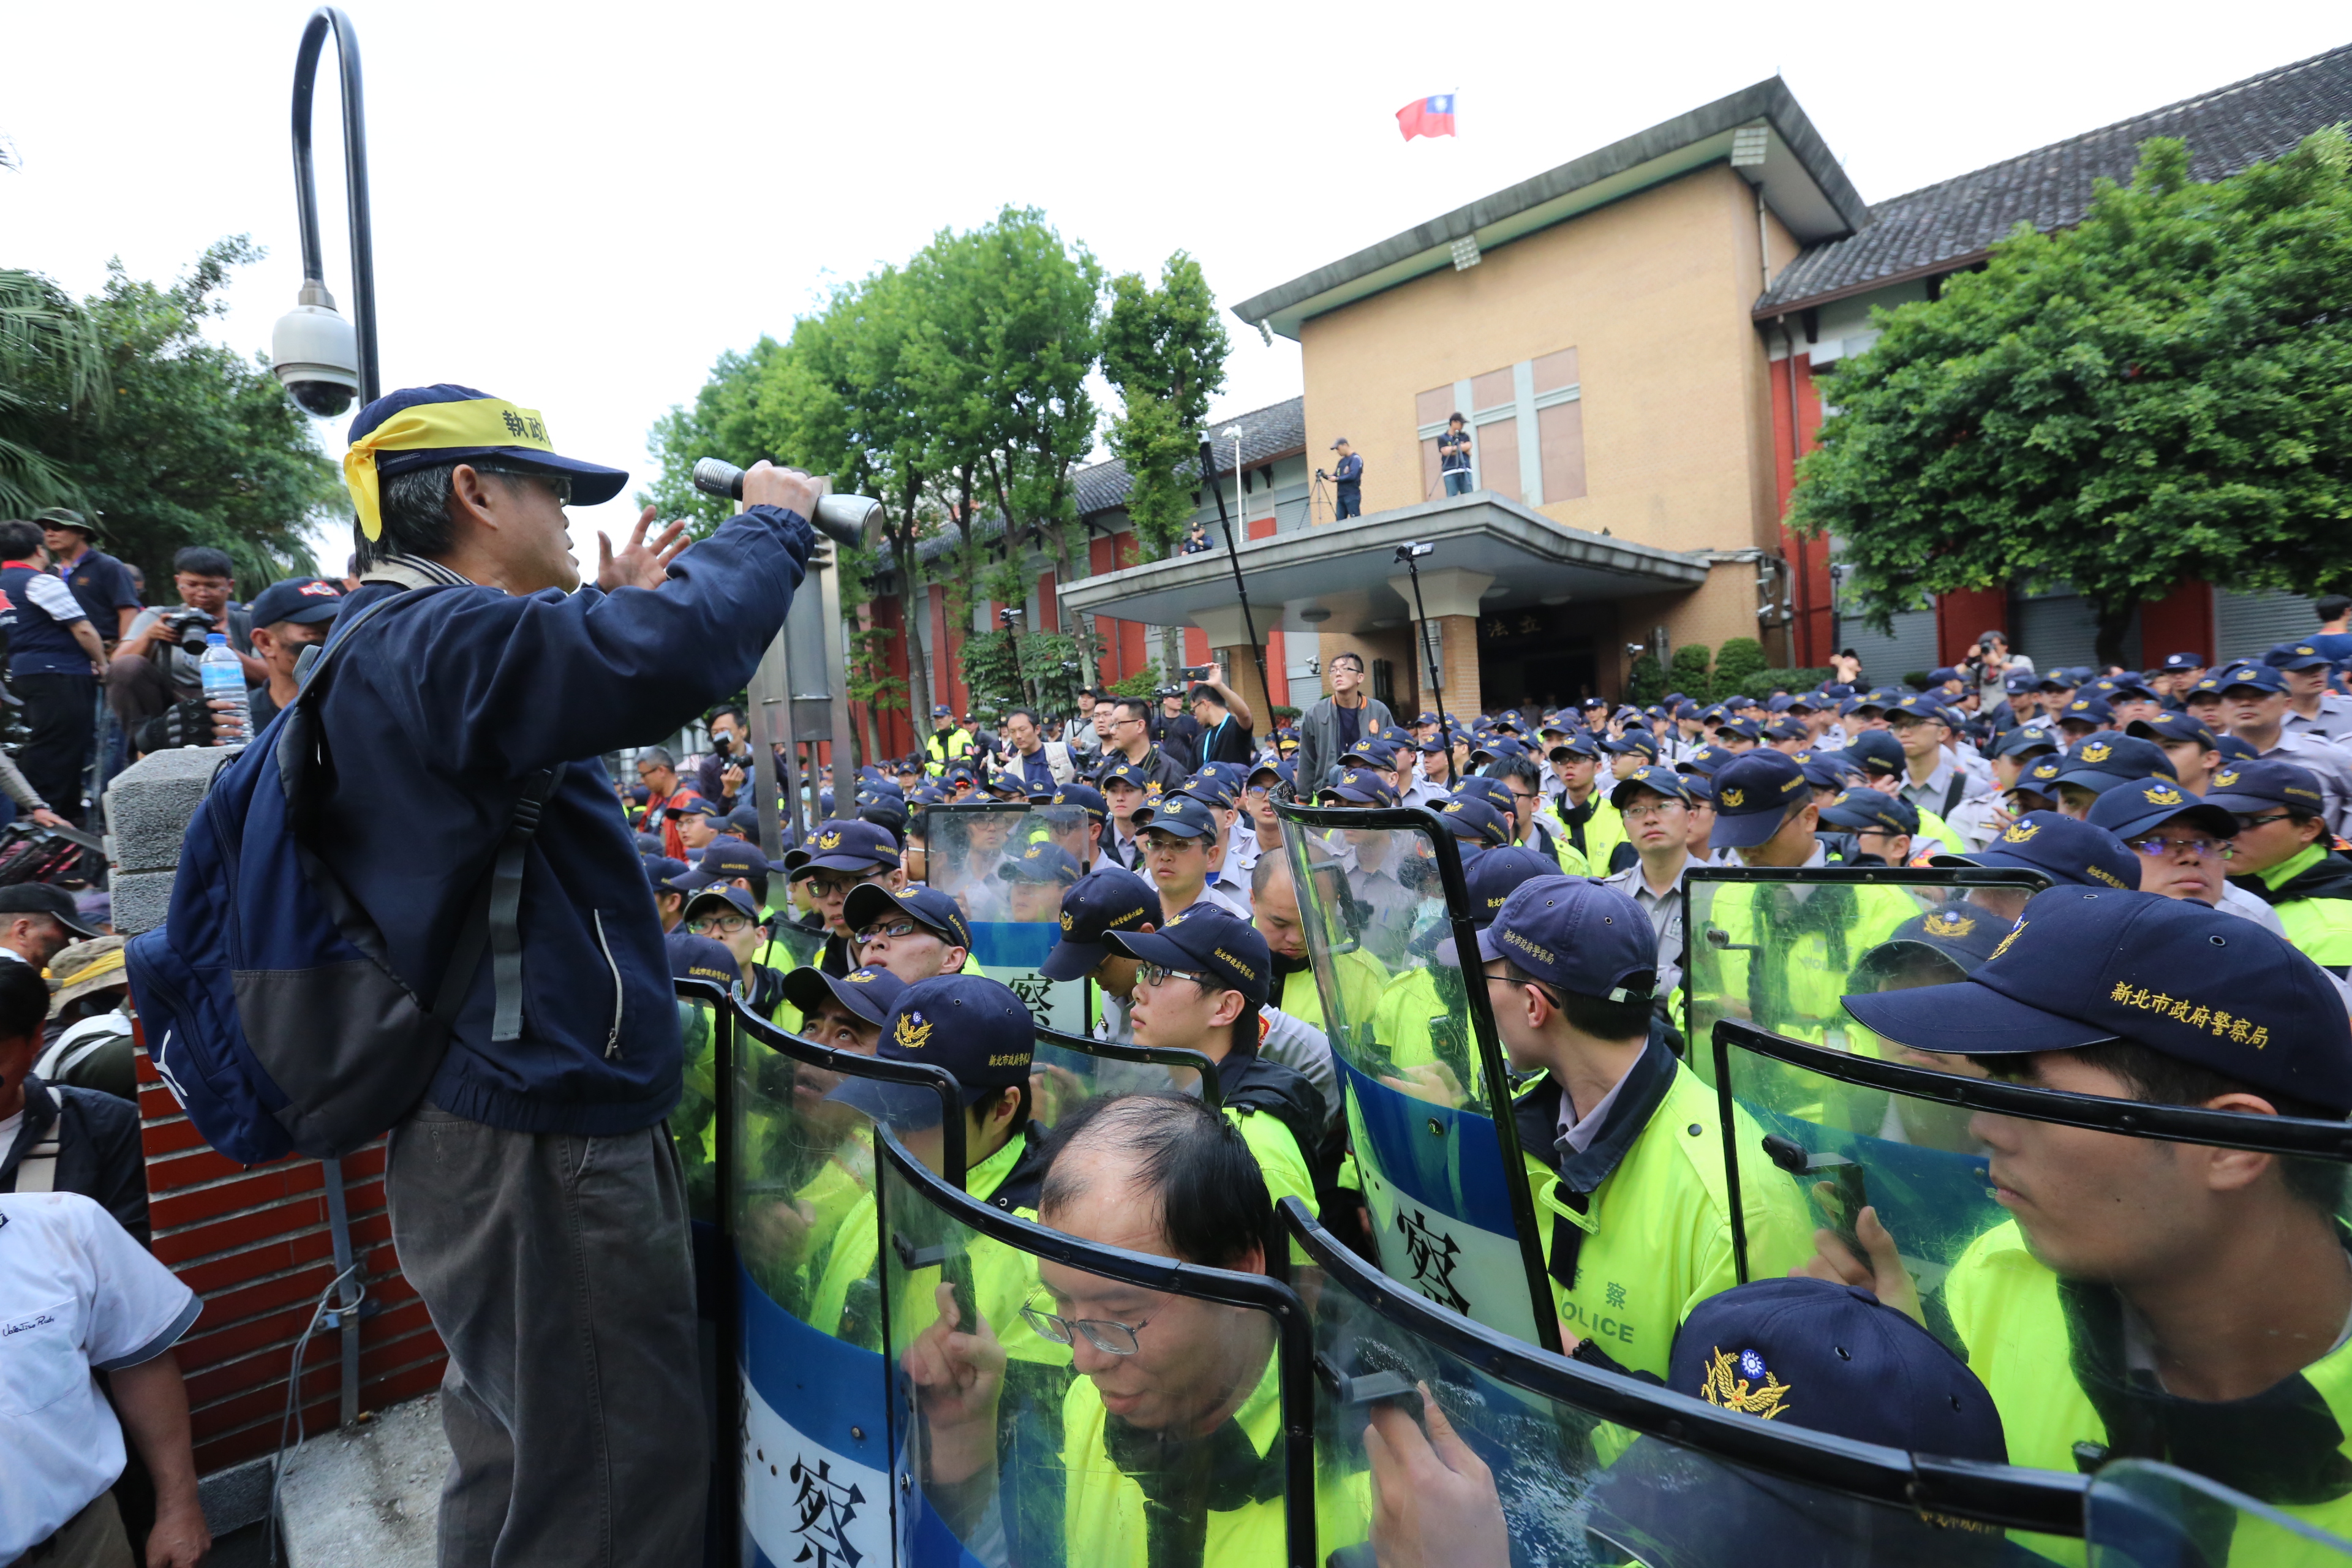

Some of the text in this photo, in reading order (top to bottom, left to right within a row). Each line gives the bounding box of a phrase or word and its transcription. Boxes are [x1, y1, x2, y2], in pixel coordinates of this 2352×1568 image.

[502, 410, 553, 447] 執政
[1214, 947, 1256, 981] 新北市政府警察局
[1503, 928, 1555, 965] 新北市政府警察局
[1008, 973, 1055, 1027] 察
[2110, 981, 2269, 1050] 新北市政府警察局
[1397, 1203, 1472, 1318] 察
[1561, 1296, 1635, 1344] OLICE
[790, 1452, 867, 1568] 察
